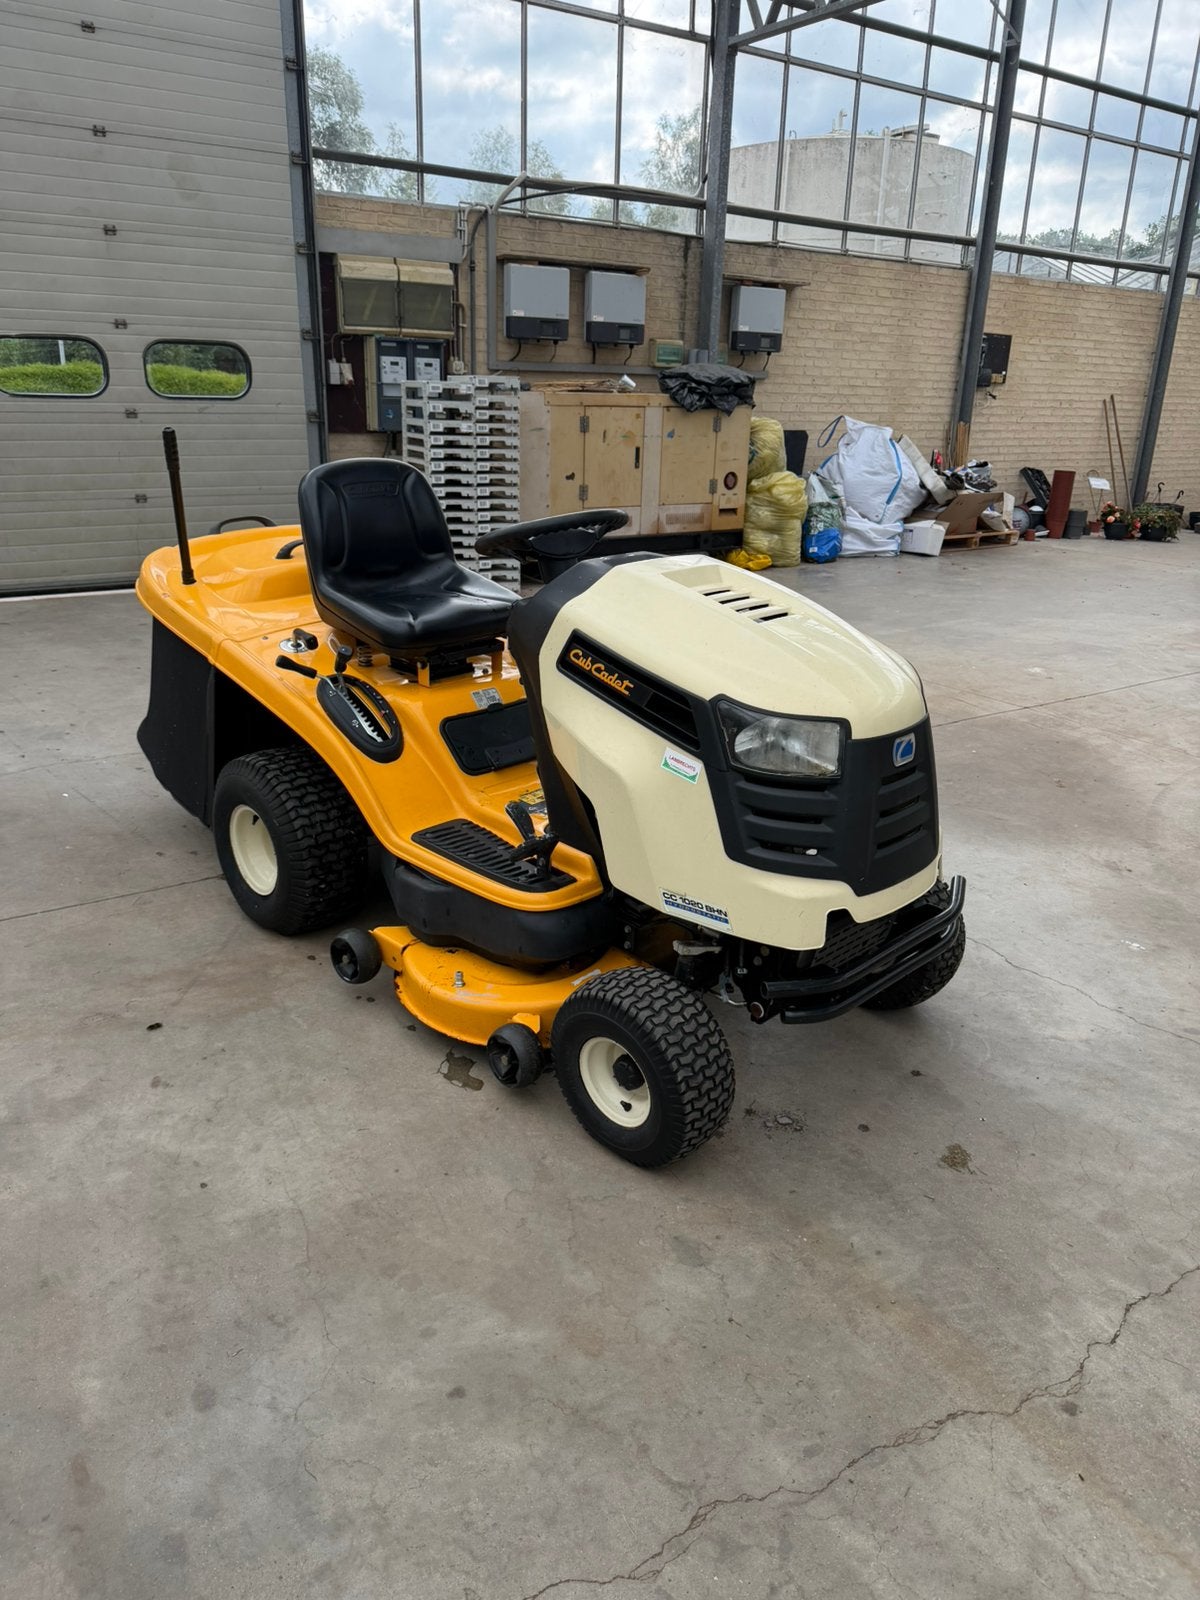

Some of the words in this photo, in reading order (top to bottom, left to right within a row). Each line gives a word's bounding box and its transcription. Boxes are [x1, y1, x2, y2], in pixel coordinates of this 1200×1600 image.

[569, 649, 591, 671] Cub
[591, 663, 634, 695] Cadet
[662, 892, 678, 901] CC
[679, 896, 704, 910] 1020
